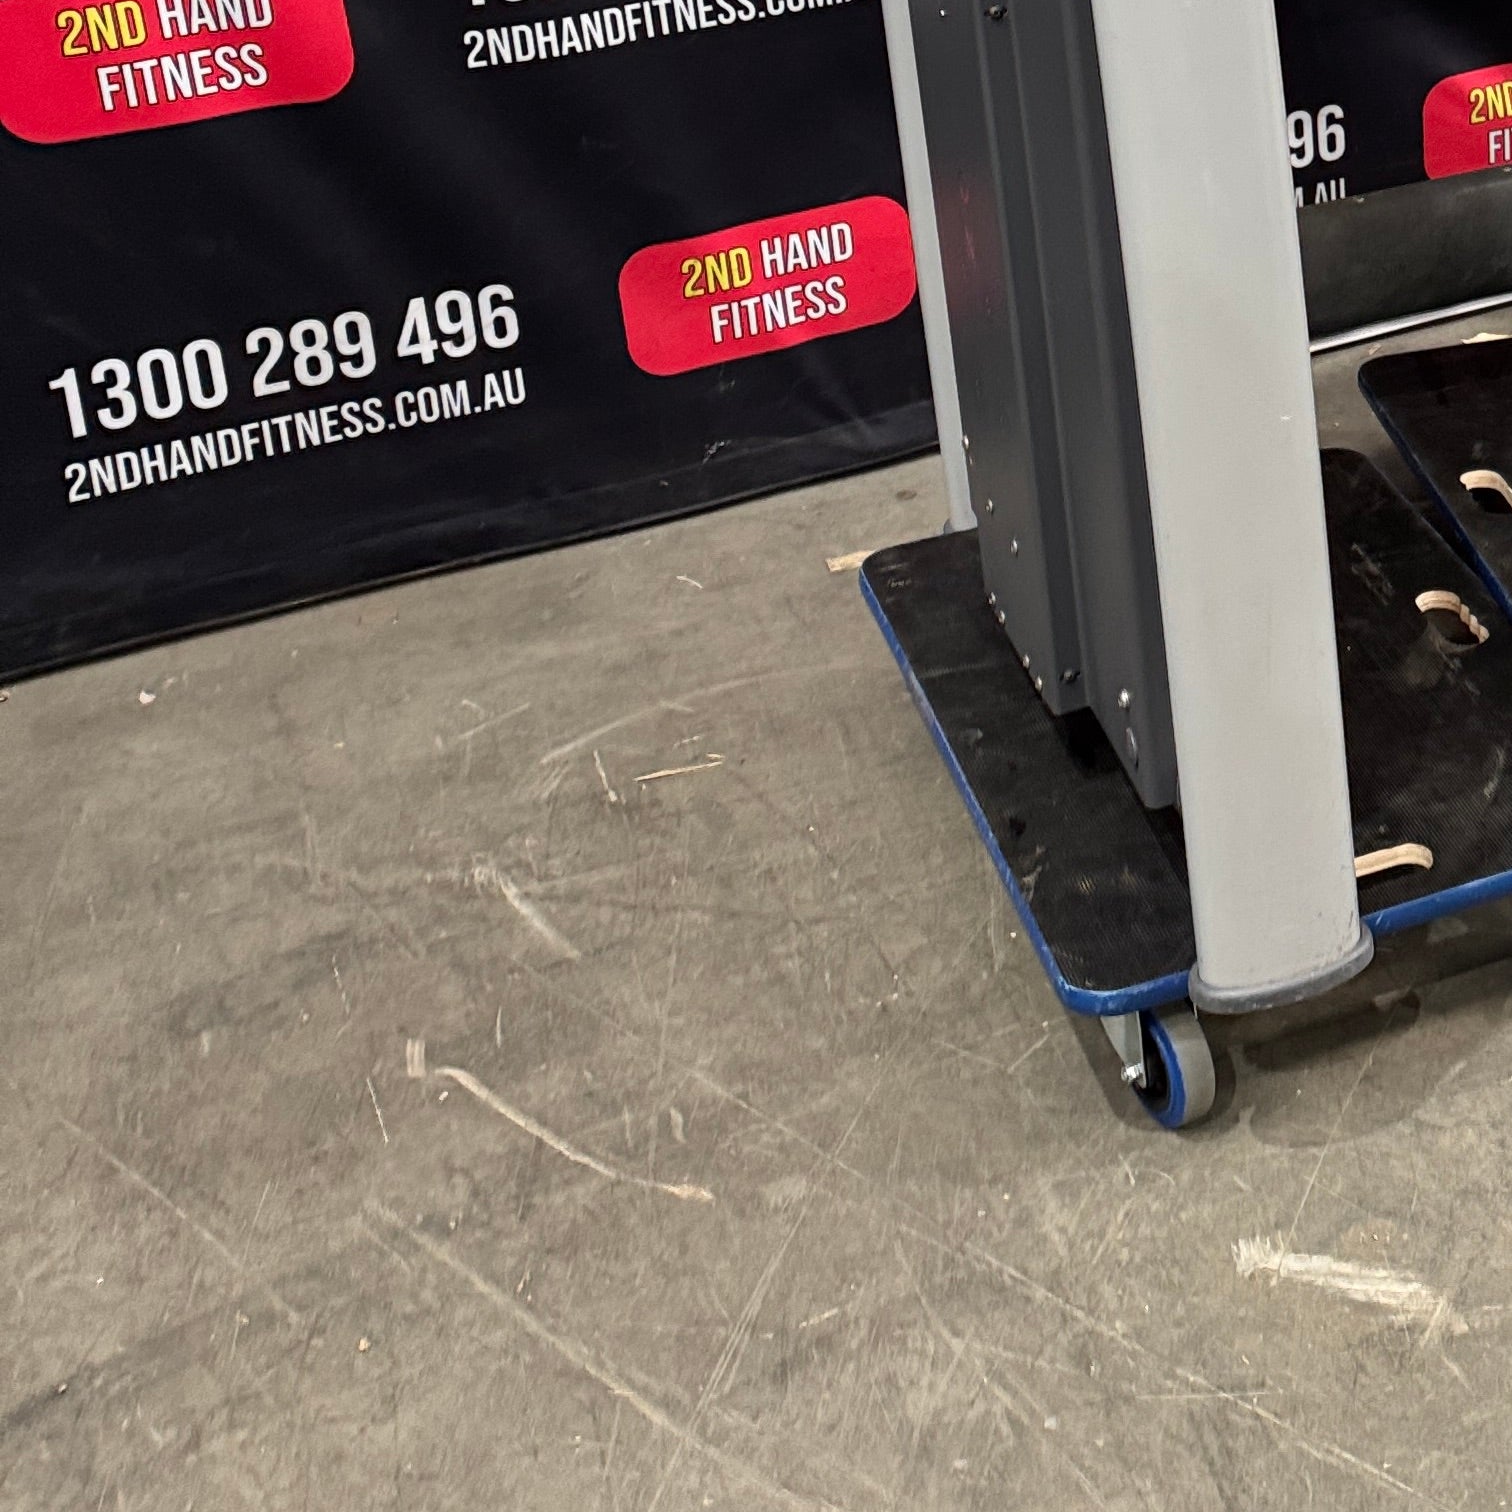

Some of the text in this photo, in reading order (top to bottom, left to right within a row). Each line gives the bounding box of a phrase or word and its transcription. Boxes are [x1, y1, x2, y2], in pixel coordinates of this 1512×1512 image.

[57, 0, 146, 56] 2ND
[94, 40, 268, 111] FITNESS
[681, 222, 853, 298] 2ND HAND
[710, 276, 847, 343] FITNESS
[48, 284, 520, 438] 1300 289 496
[64, 367, 526, 503] 2NDHANDFITNESS.COM.AU
